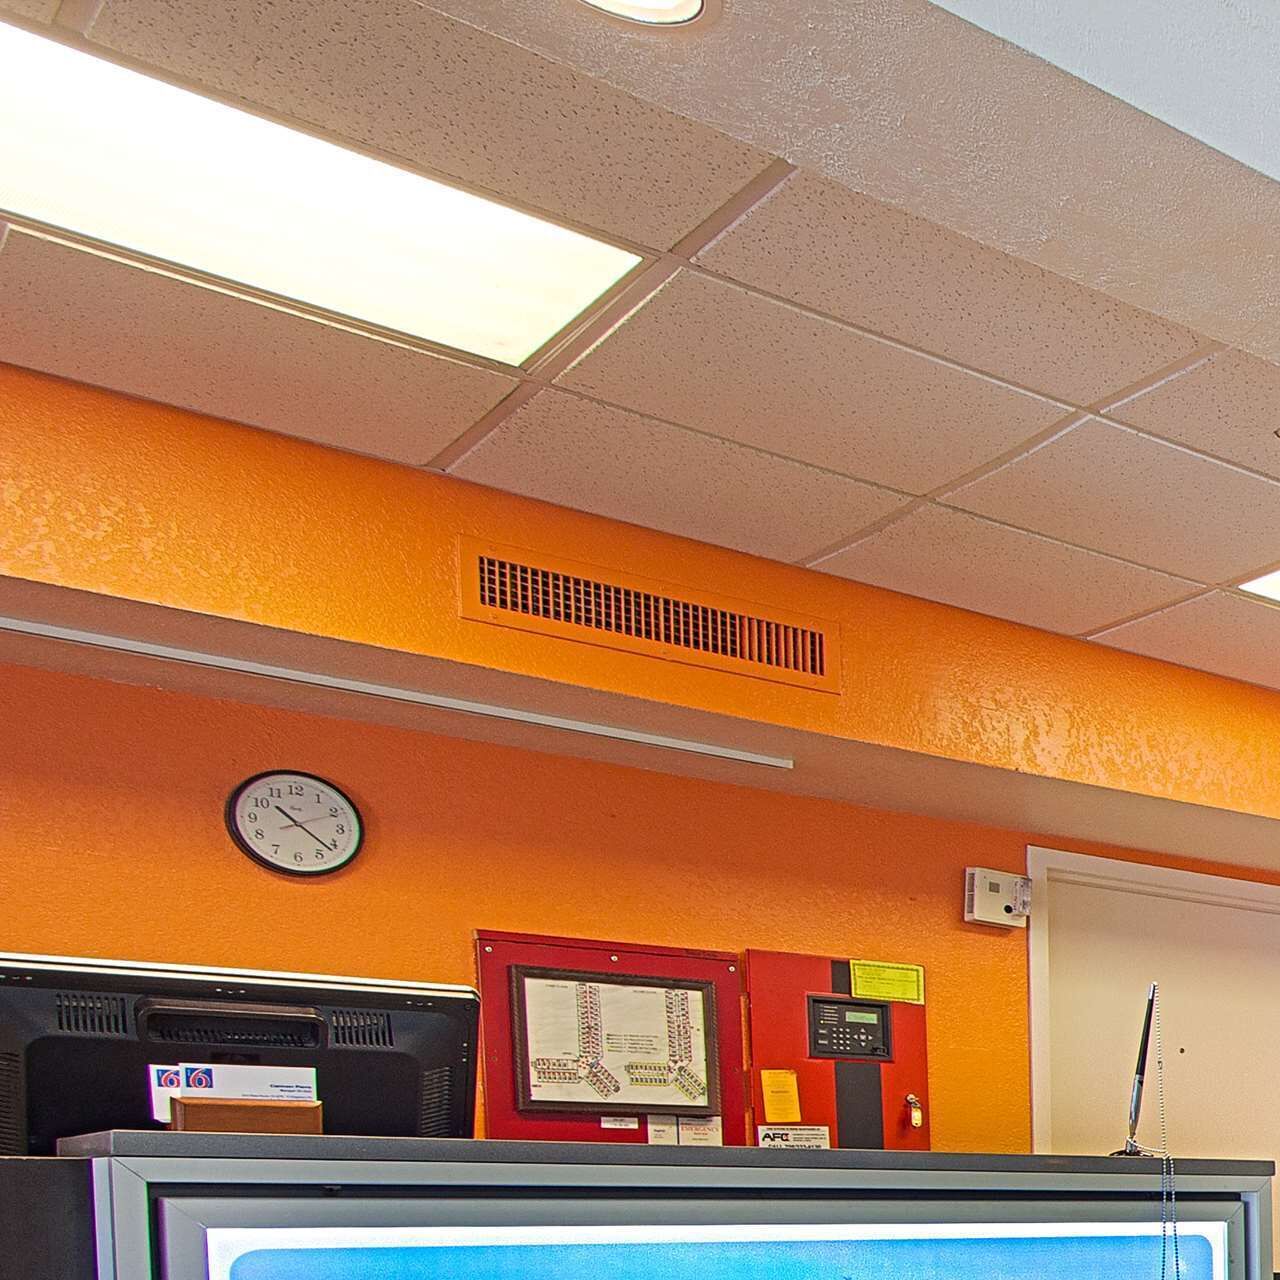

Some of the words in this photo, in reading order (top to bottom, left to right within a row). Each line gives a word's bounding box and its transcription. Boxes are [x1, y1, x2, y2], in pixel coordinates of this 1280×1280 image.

[269, 788, 282, 799] 11
[288, 784, 304, 797] 12
[253, 797, 270, 809] 10
[315, 793, 322, 804] 1
[248, 811, 258, 823] 9
[329, 806, 339, 818] 2
[254, 828, 265, 840] 8
[336, 823, 345, 835] 3
[271, 844, 280, 855] 7
[315, 848, 325, 860] 5
[294, 852, 304, 863] 6
[190, 1069, 211, 1088] 6
